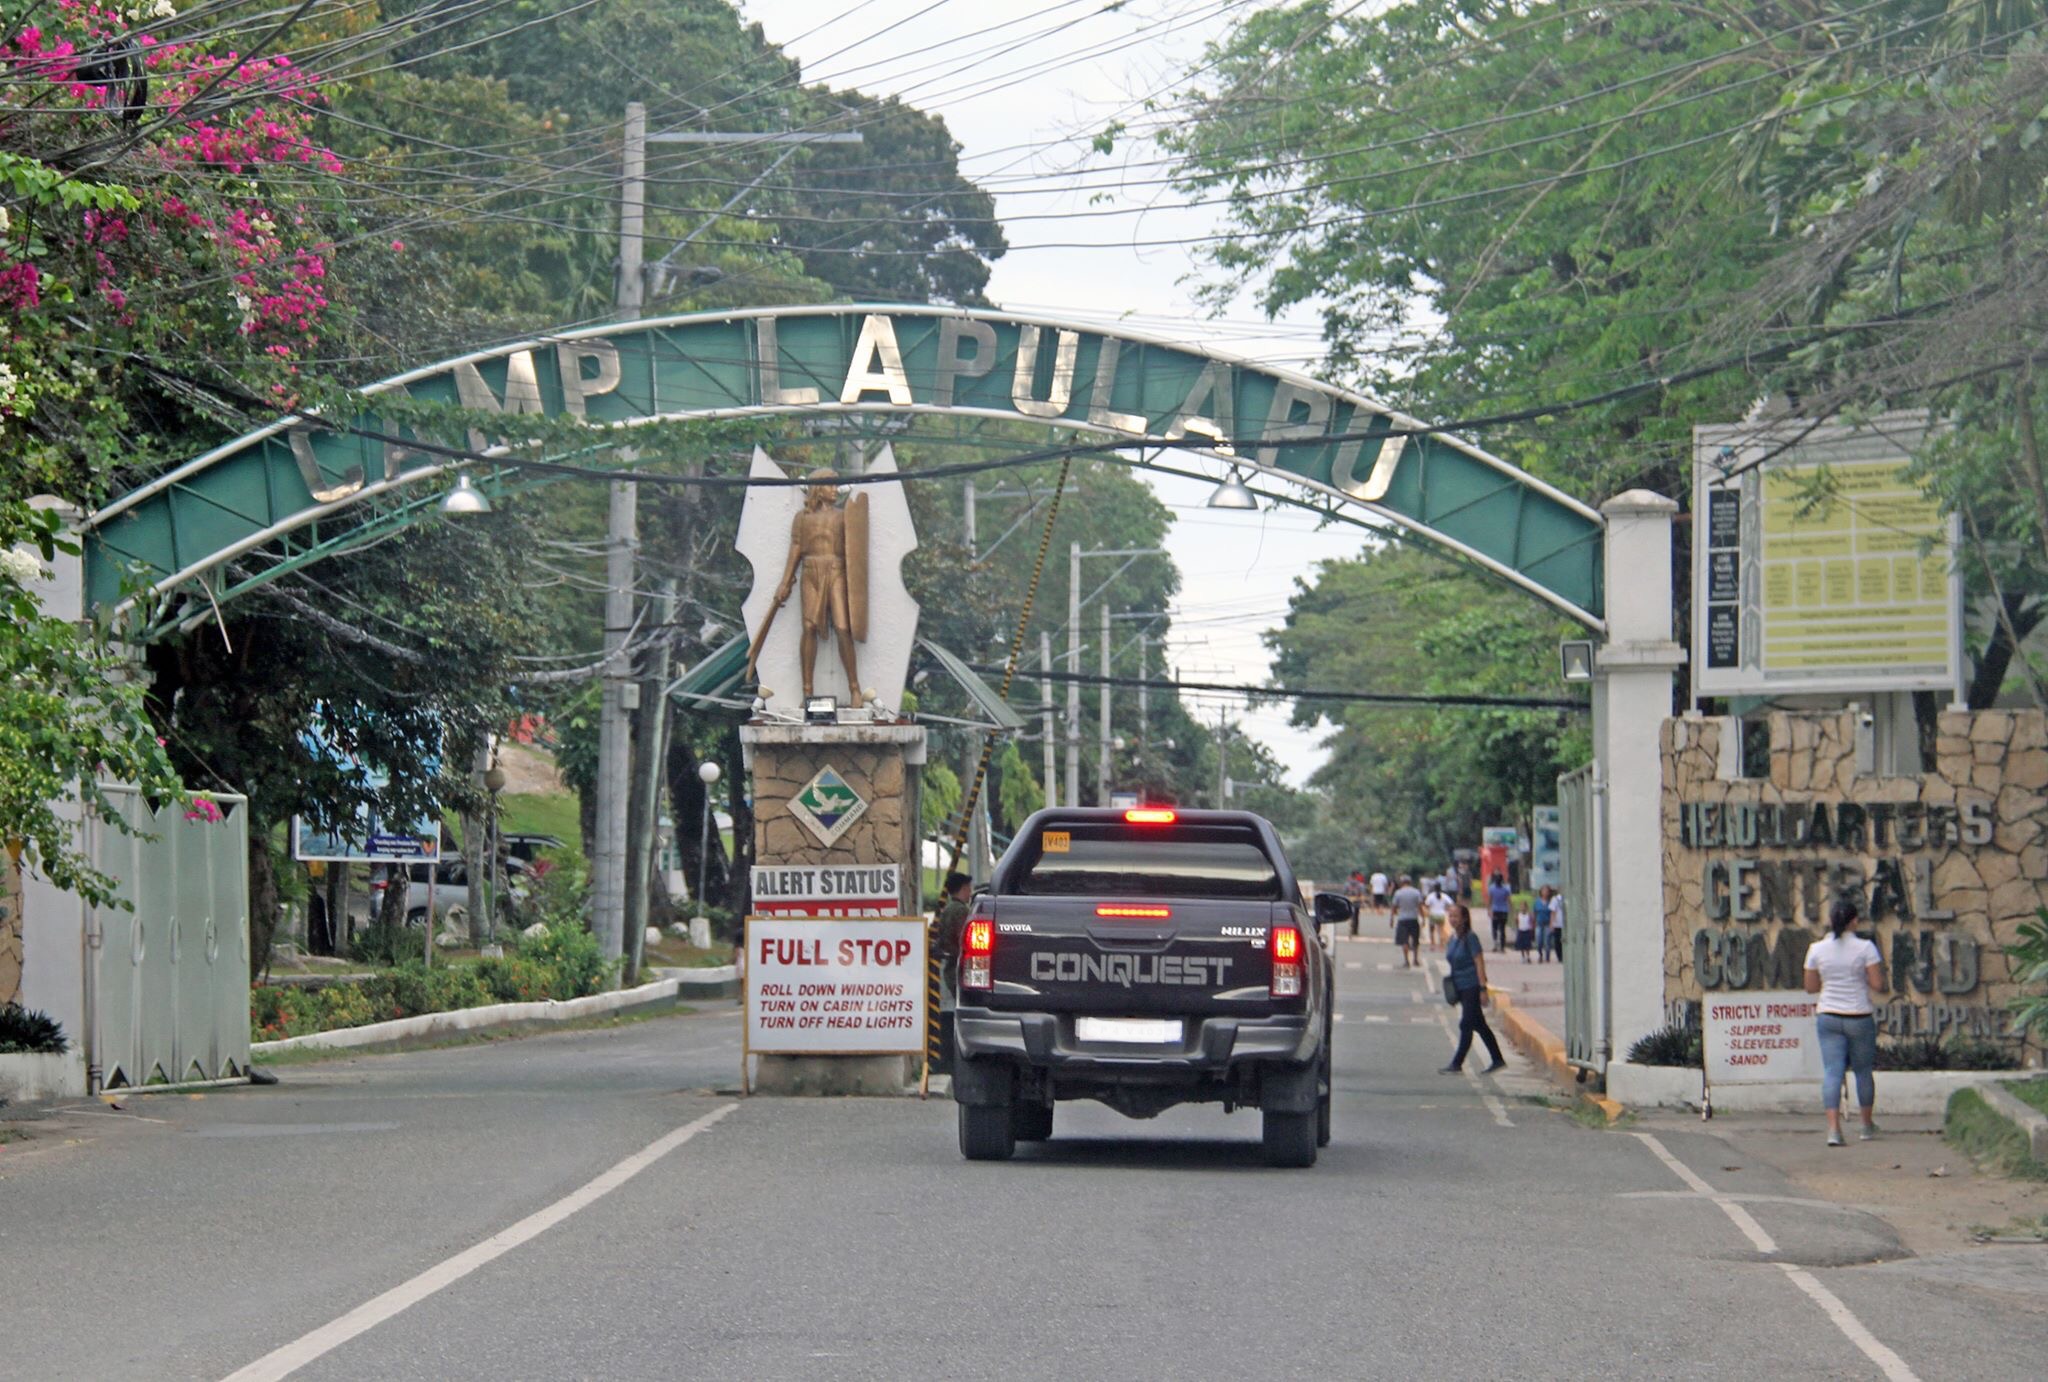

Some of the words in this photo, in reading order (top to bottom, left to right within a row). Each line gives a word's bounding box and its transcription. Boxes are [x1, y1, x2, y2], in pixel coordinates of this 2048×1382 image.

[1680, 801, 1994, 847] HEADQUARTERS
[756, 871, 815, 895] ALERT
[820, 869, 895, 894] STATUS
[1704, 858, 1955, 922] CENTRAL
[999, 923, 1032, 932] TOYOTA
[761, 938, 829, 966] FULL
[838, 938, 911, 967] STOP
[1030, 951, 1233, 988] CONQUEST
[761, 984, 793, 996] ROLL
[798, 984, 836, 996] DOWN
[841, 983, 904, 996] WINDOWS
[760, 1000, 796, 1012] TURN
[800, 1000, 819, 1012] ON
[823, 1000, 863, 1012] CABIN
[867, 1000, 914, 1012] LIGHTS
[1712, 1005, 1760, 1020] STRICTLY
[1767, 1002, 1817, 1019] PROHIBIT
[760, 1016, 796, 1029] TURN
[799, 1016, 825, 1029] OFF
[826, 1016, 862, 1029] HEAD
[865, 1015, 913, 1029] LIGHTS
[1872, 1003, 2025, 1038] PHILIPPINE
